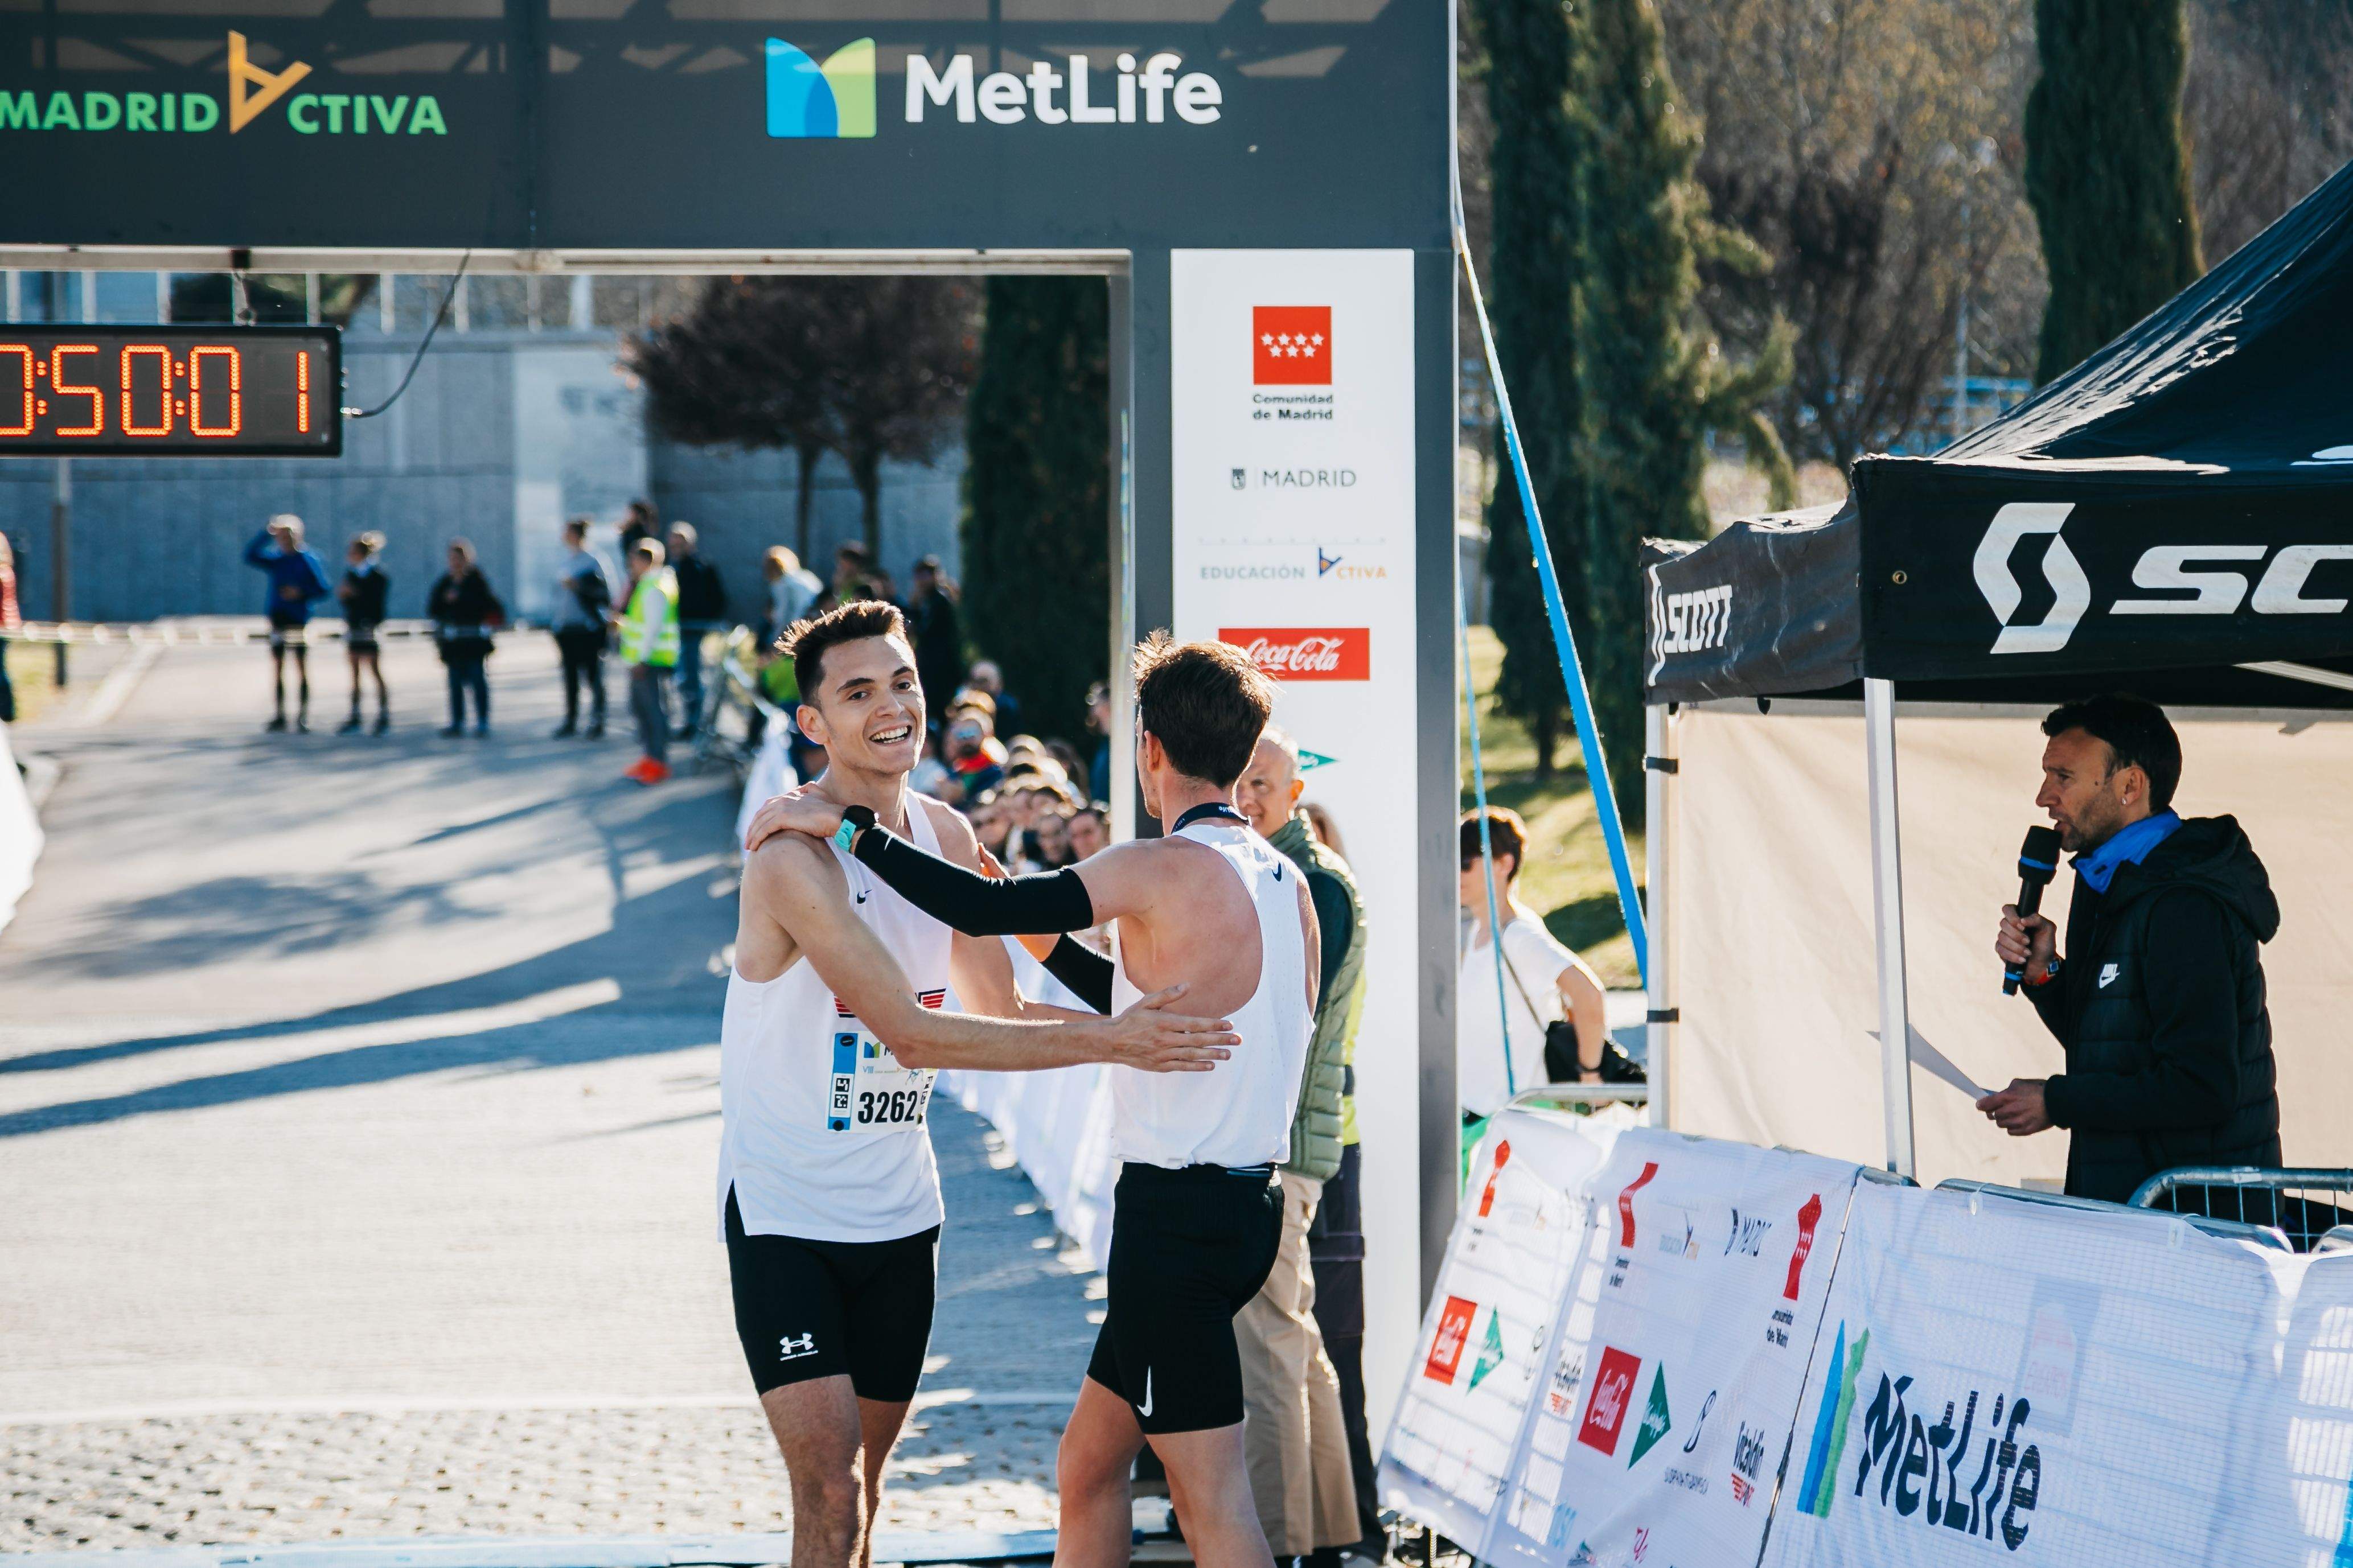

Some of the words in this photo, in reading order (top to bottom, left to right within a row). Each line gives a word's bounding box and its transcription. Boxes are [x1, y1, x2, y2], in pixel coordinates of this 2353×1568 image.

[905, 53, 1222, 124] MetLife
[0, 91, 220, 131] MADRID
[1253, 394, 1333, 404] Comunidad
[1253, 409, 1271, 420] de
[1279, 409, 1333, 420] Madrid
[1262, 470, 1356, 487] MADRID
[1200, 564, 1305, 579] EDUCACIÓN
[1664, 585, 1732, 653] SCOTT
[858, 1091, 917, 1123] 3262
[1854, 1372, 2042, 1551] MetLife
